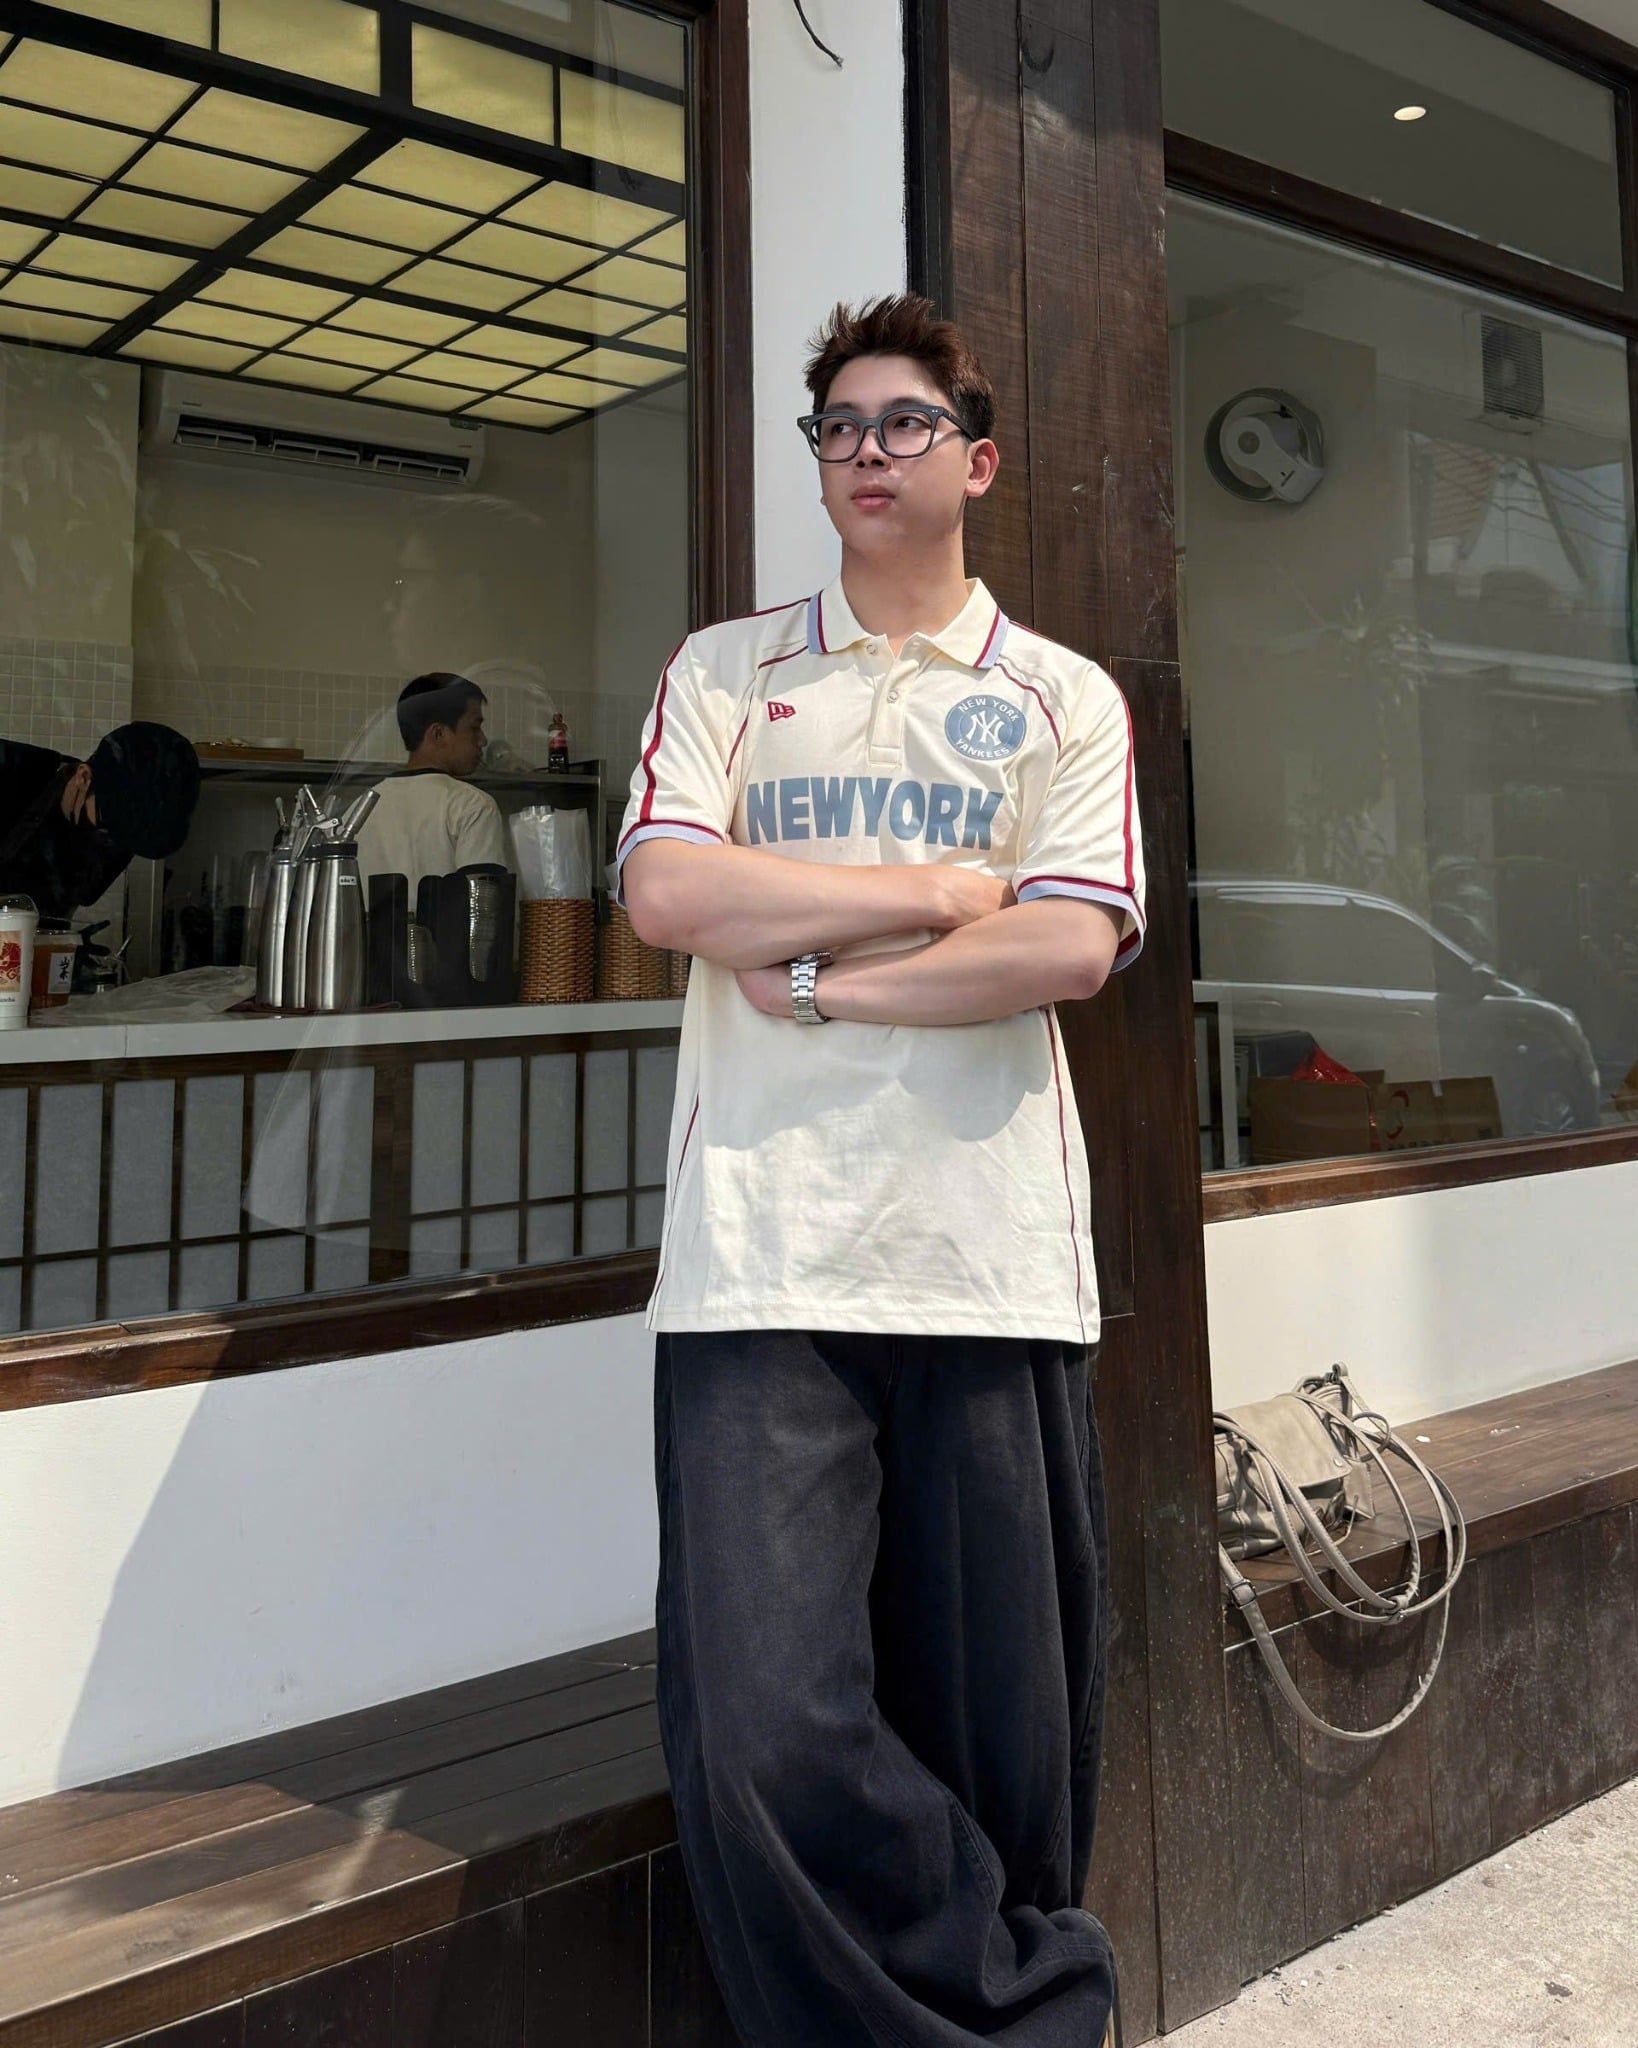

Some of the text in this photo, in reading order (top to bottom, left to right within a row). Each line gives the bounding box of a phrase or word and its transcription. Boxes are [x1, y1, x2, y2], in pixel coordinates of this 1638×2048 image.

[957, 698, 1020, 722] NEW YORK
[966, 710, 1005, 746] NY
[956, 738, 1010, 758] YANKEES
[747, 776, 1004, 850] NEWYORK
